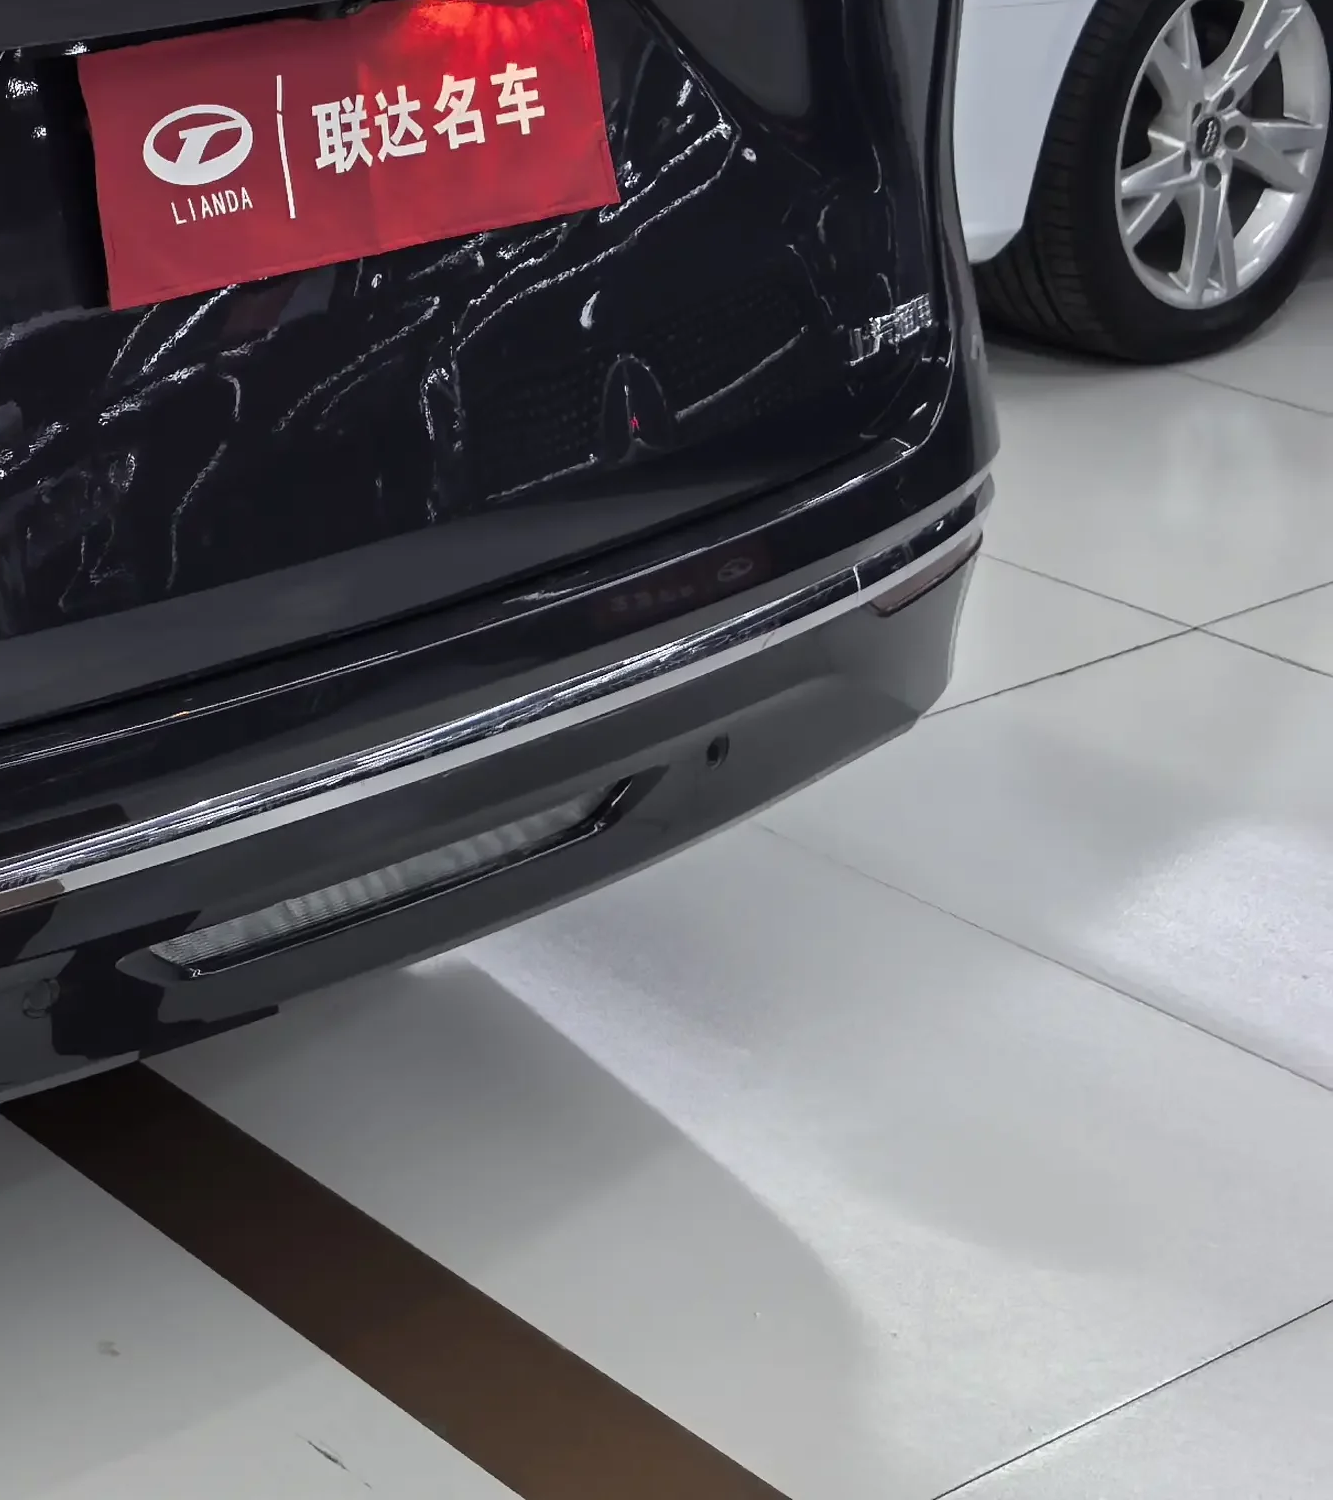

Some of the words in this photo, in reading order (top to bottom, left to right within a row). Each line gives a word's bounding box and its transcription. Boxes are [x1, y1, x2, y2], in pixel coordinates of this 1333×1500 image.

[311, 61, 546, 174] 联达名车
[170, 189, 254, 226] LIANDA
